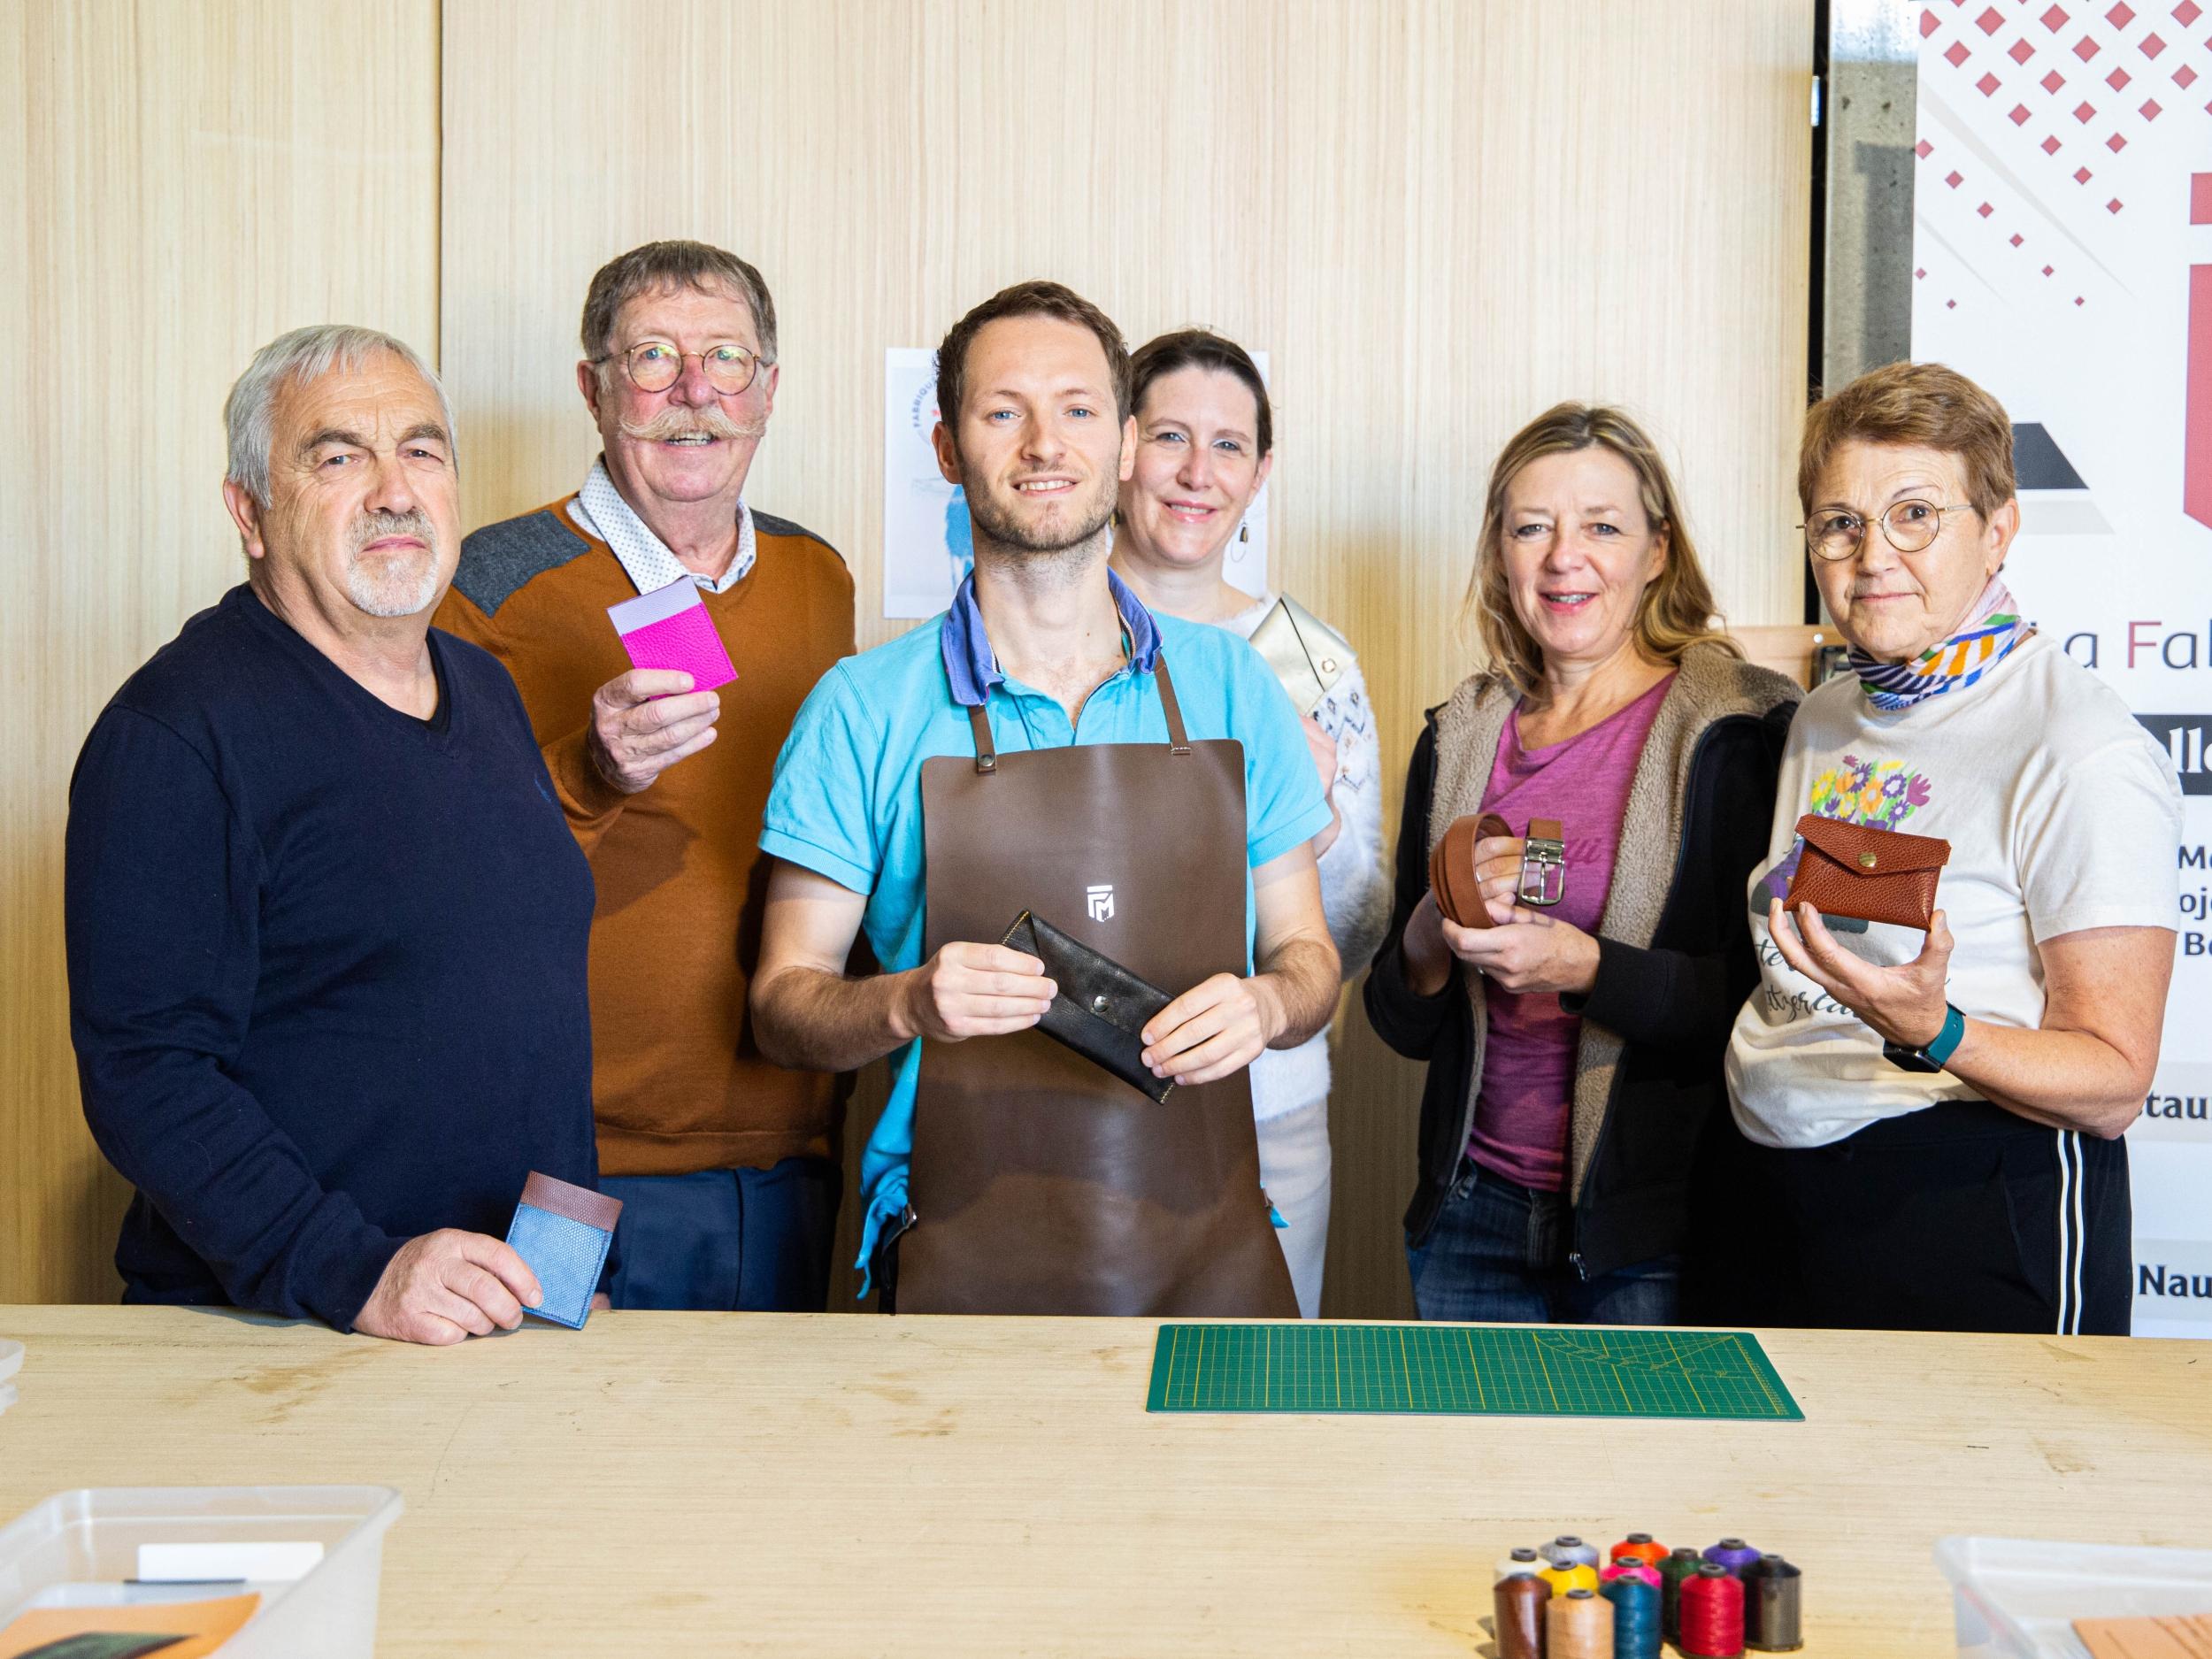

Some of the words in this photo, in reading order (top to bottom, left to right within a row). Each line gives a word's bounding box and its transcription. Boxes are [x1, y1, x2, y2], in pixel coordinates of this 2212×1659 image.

[2128, 621, 2212, 670] Fa
[2177, 846, 2212, 870] M
[2185, 932, 2212, 956] B
